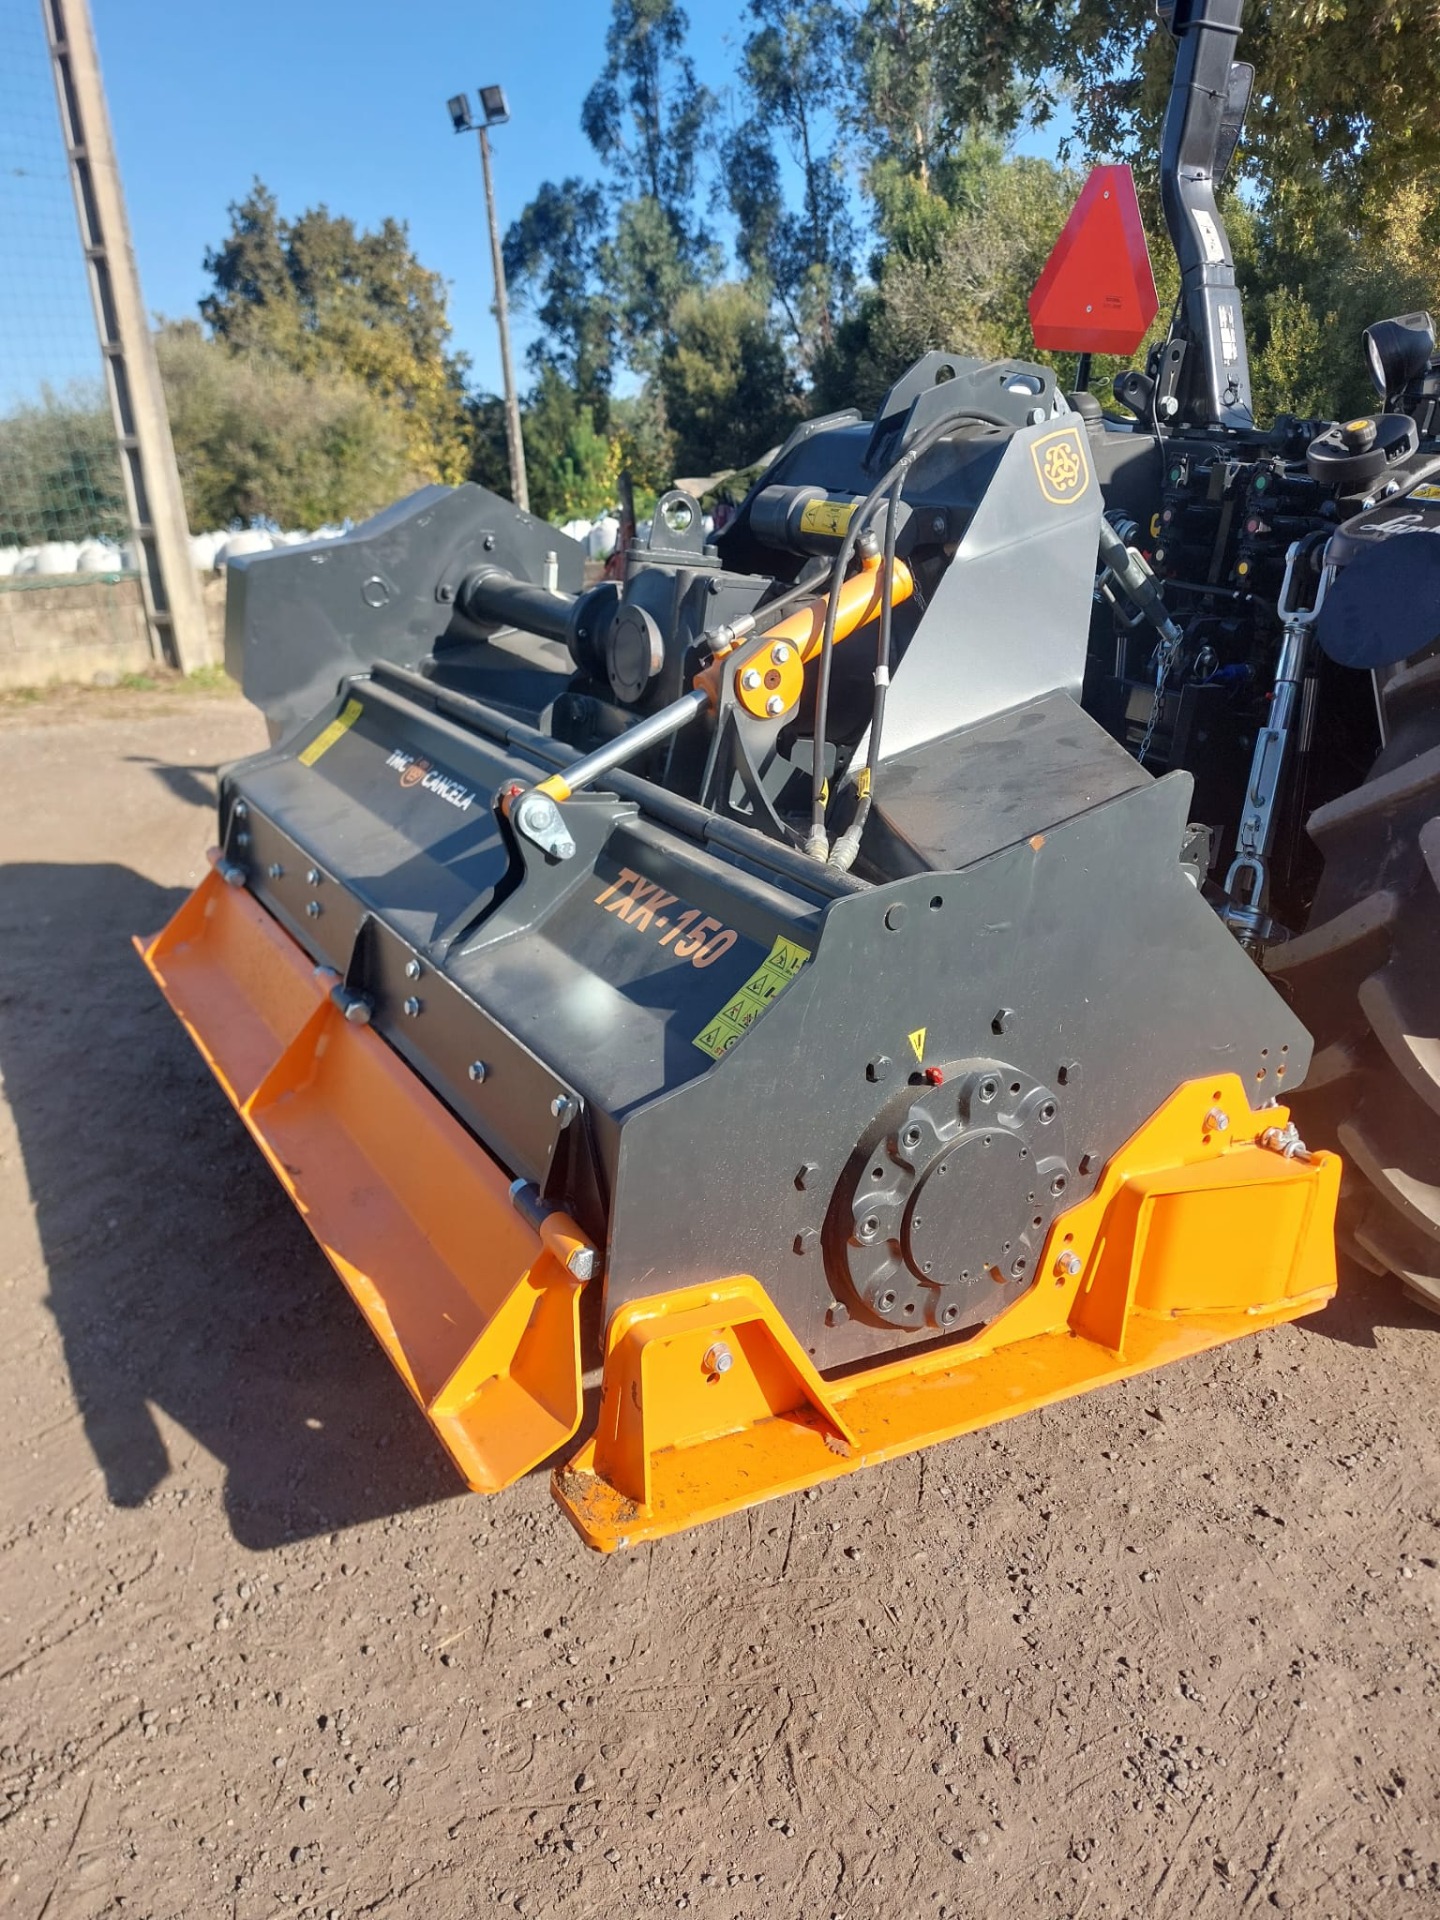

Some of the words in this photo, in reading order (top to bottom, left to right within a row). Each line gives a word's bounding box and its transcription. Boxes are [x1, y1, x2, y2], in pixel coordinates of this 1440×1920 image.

[385, 748, 414, 773] TMC
[421, 770, 476, 811] CANCELA
[593, 866, 738, 969] TXK-150
